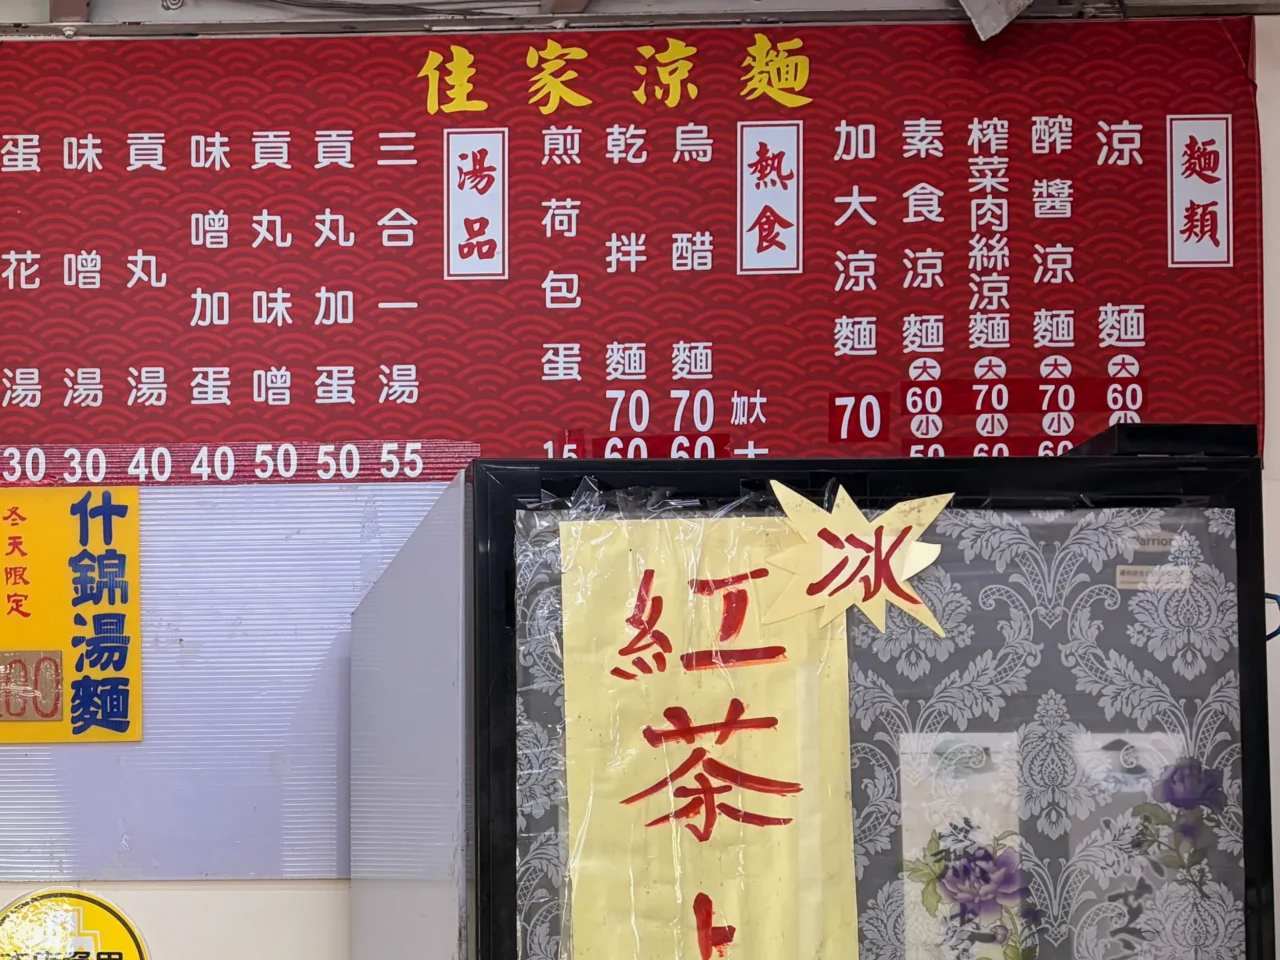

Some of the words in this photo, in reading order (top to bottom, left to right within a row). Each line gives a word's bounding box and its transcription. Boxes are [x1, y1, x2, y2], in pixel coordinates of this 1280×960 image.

[418, 33, 813, 115] 佳家涼麵
[0, 134, 41, 407] 蛋花湯
[63, 134, 104, 407] 味噌湯
[126, 132, 167, 406] 貢丸湯
[190, 131, 231, 405] 味噌加蛋
[252, 131, 293, 405] 貢丸味噌
[314, 130, 356, 404] 貢丸加蛋
[377, 131, 419, 404] 三合一湯
[457, 148, 497, 260] 湯品
[541, 125, 582, 381] 煎荷包蛋
[605, 124, 647, 380] 乾拌麵
[671, 123, 713, 380] 烏醋麵
[746, 142, 794, 254] 熱食
[834, 120, 877, 356] 加大涼麵
[902, 118, 944, 354] 素食涼麵
[967, 118, 1010, 349] 榨菜肉絲涼麵
[1096, 120, 1145, 347] 涼麵
[1180, 135, 1222, 247] 麵類
[2, 447, 46, 482] 30
[63, 448, 107, 482] 30
[127, 446, 172, 481] 40
[190, 445, 235, 480] 40
[254, 443, 297, 478] 50
[317, 444, 360, 479] 50
[380, 442, 423, 477] 55
[606, 389, 649, 432] 70
[670, 389, 714, 432] 70
[731, 389, 767, 425] 加大
[835, 394, 881, 439] 70
[906, 386, 942, 413] 60
[972, 384, 1008, 411] 70
[1038, 384, 1075, 411] 70
[1107, 383, 1143, 410] 60
[2, 506, 31, 618] 冬天限定
[69, 490, 131, 735] 什錦湯麵
[806, 525, 922, 604] 冰
